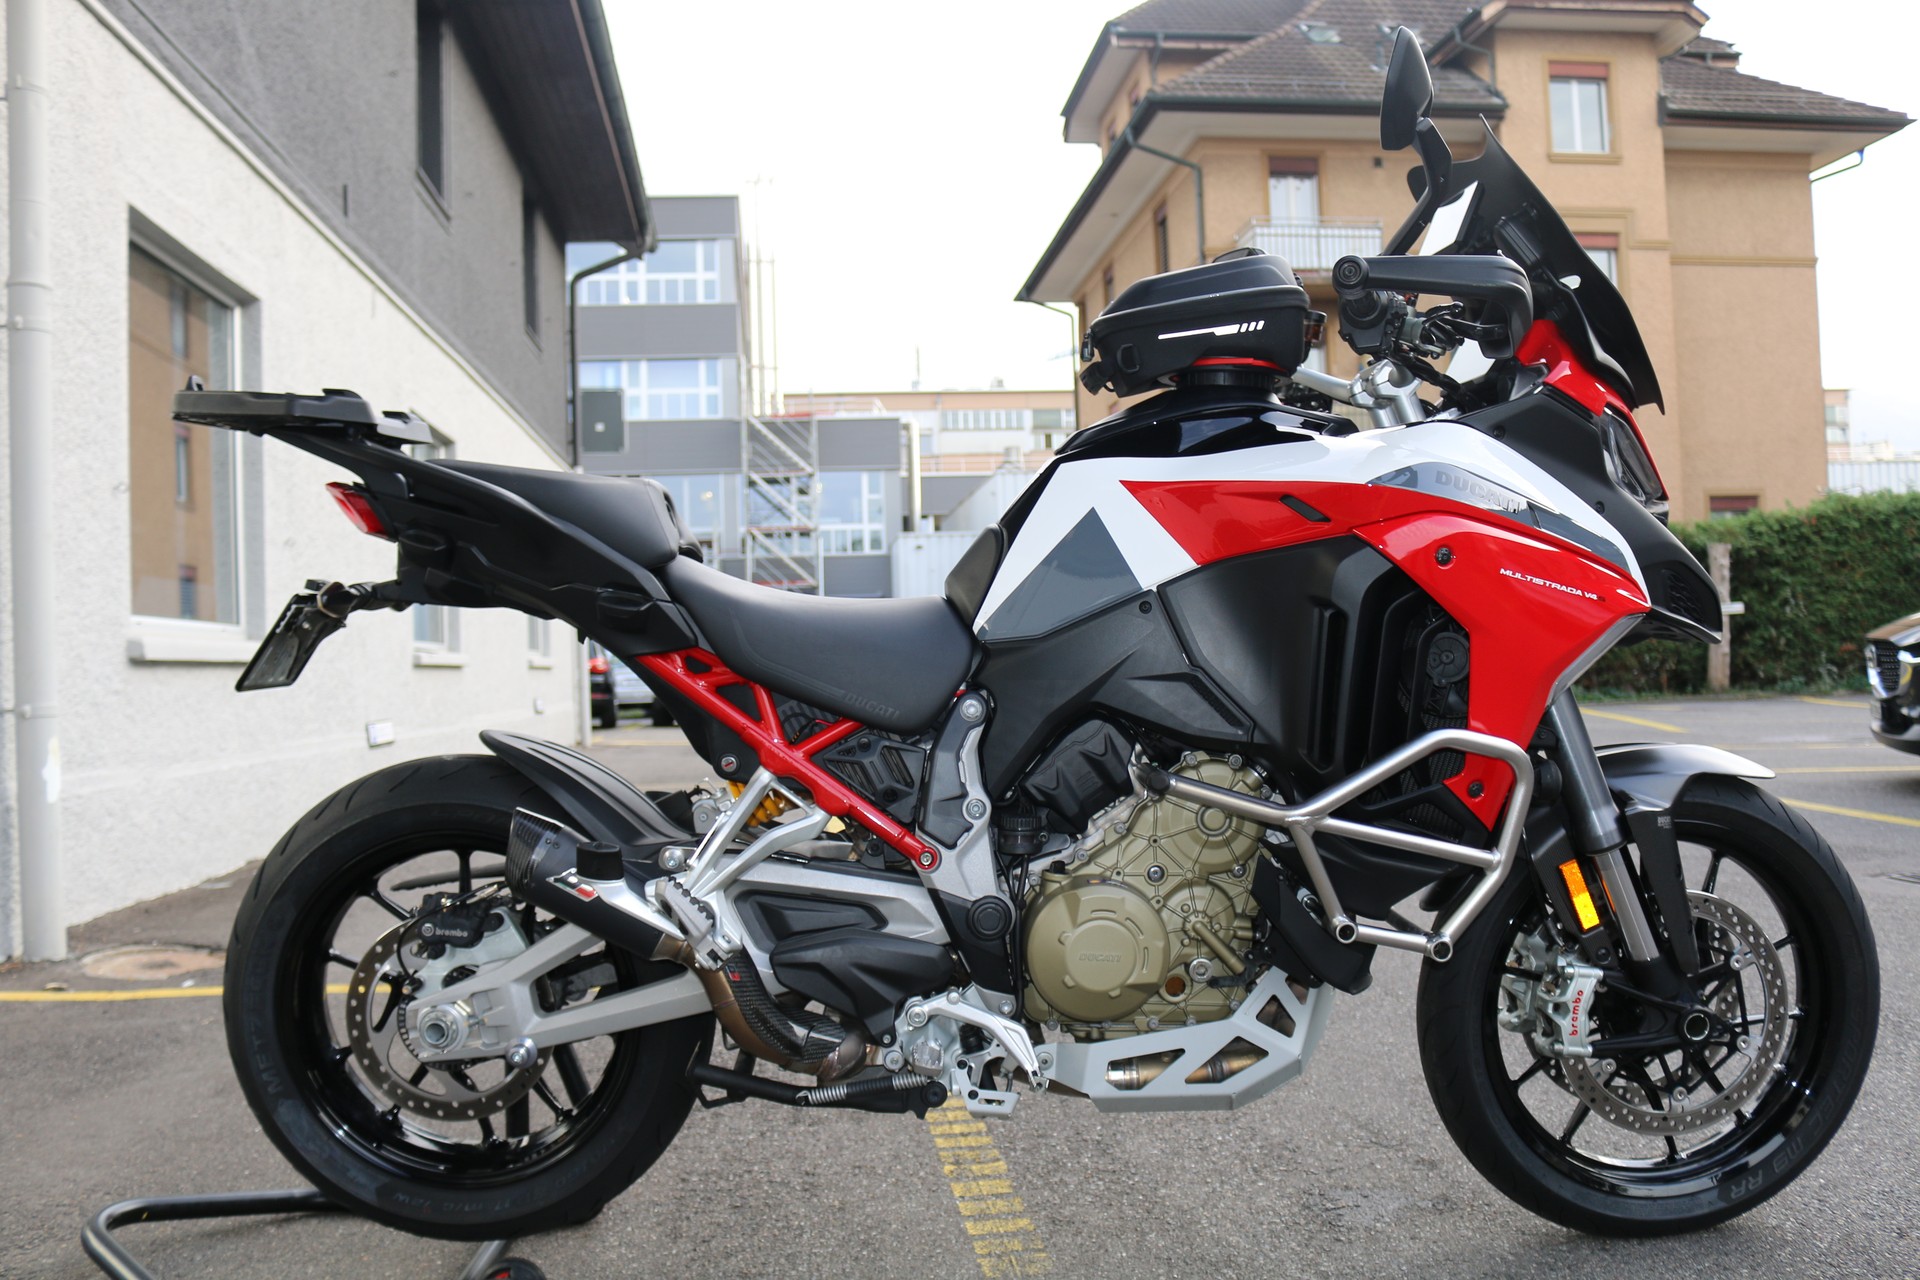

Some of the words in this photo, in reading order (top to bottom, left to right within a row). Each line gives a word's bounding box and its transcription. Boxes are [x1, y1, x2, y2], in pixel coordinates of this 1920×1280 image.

[1435, 470, 1521, 514] DUCATI
[1499, 567, 1583, 597] MULTISTRADA
[844, 692, 901, 721] DUCATI
[435, 928, 469, 938] brembo
[1079, 952, 1122, 962] DUCATI
[1568, 989, 1584, 1037] brembo
[1730, 1169, 1763, 1199] RR
